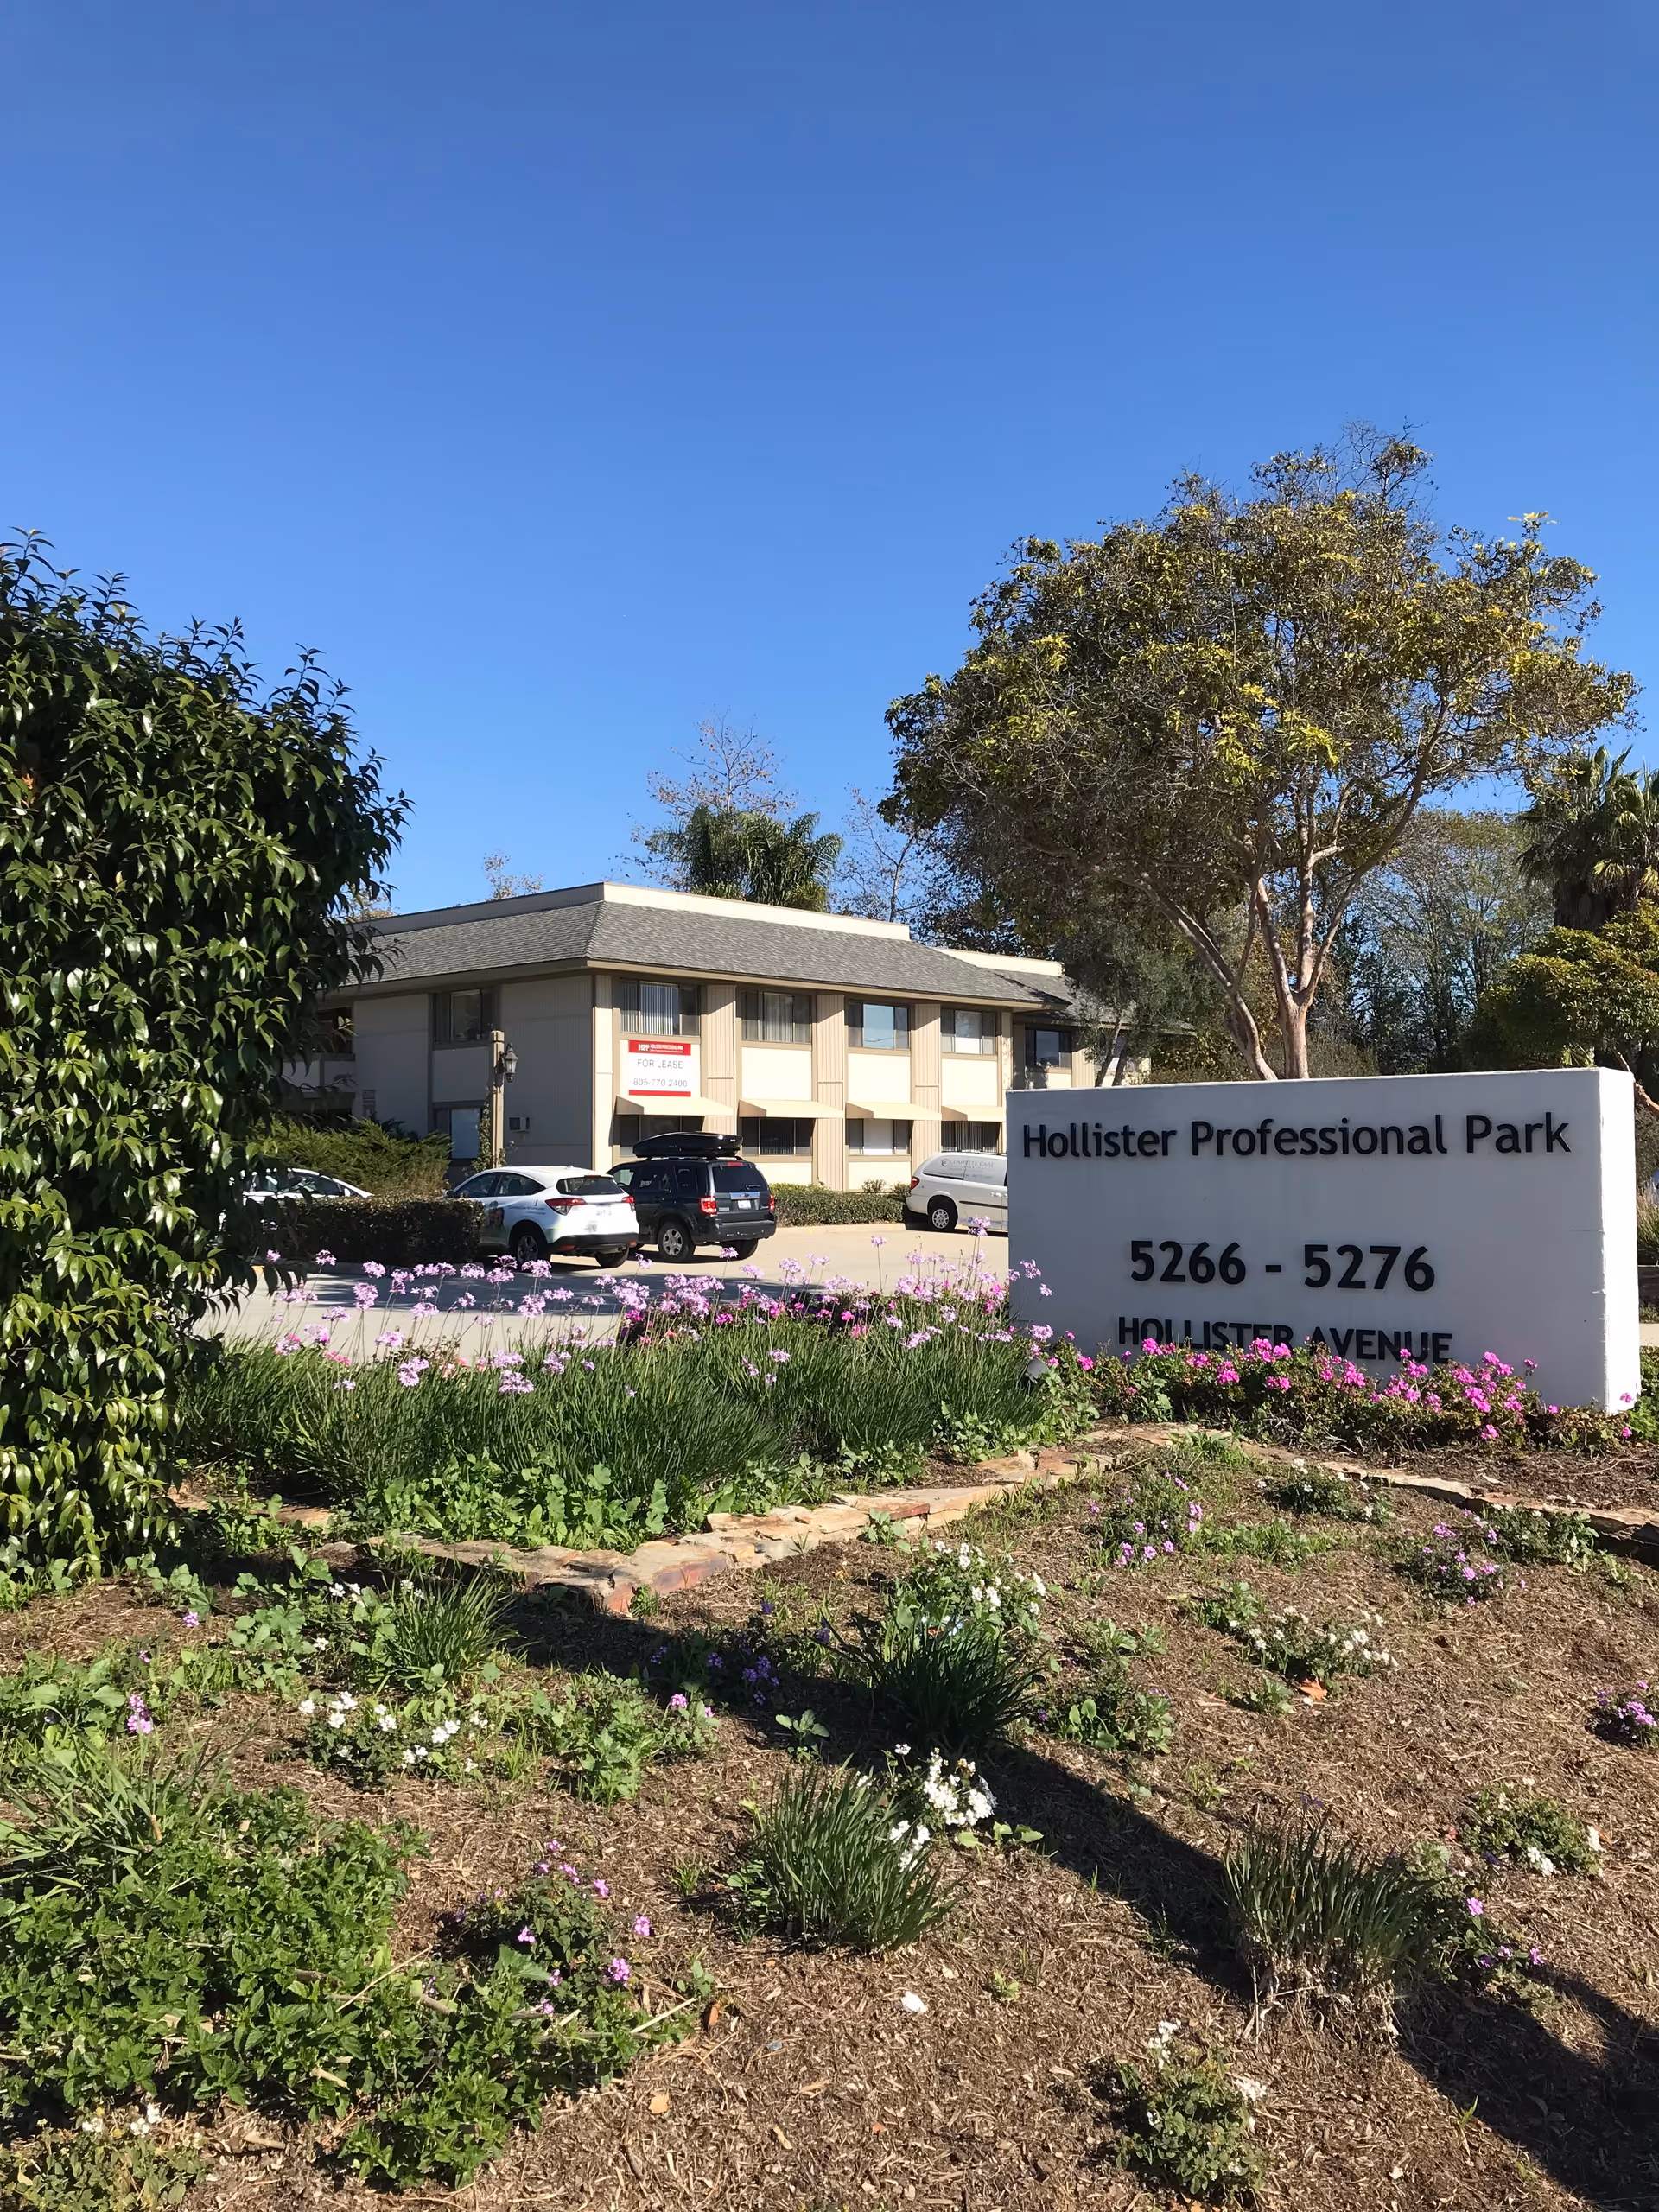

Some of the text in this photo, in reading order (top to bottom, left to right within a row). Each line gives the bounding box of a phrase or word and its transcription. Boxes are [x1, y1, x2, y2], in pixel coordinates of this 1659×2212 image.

[637, 1058, 683, 1069] FOR LEASE
[1022, 1111, 1572, 1160] Hollister Professional Park
[1130, 1239, 1435, 1293] 5266 - 5276
[1118, 1316, 1453, 1363] HOLLISTER AVENUE
